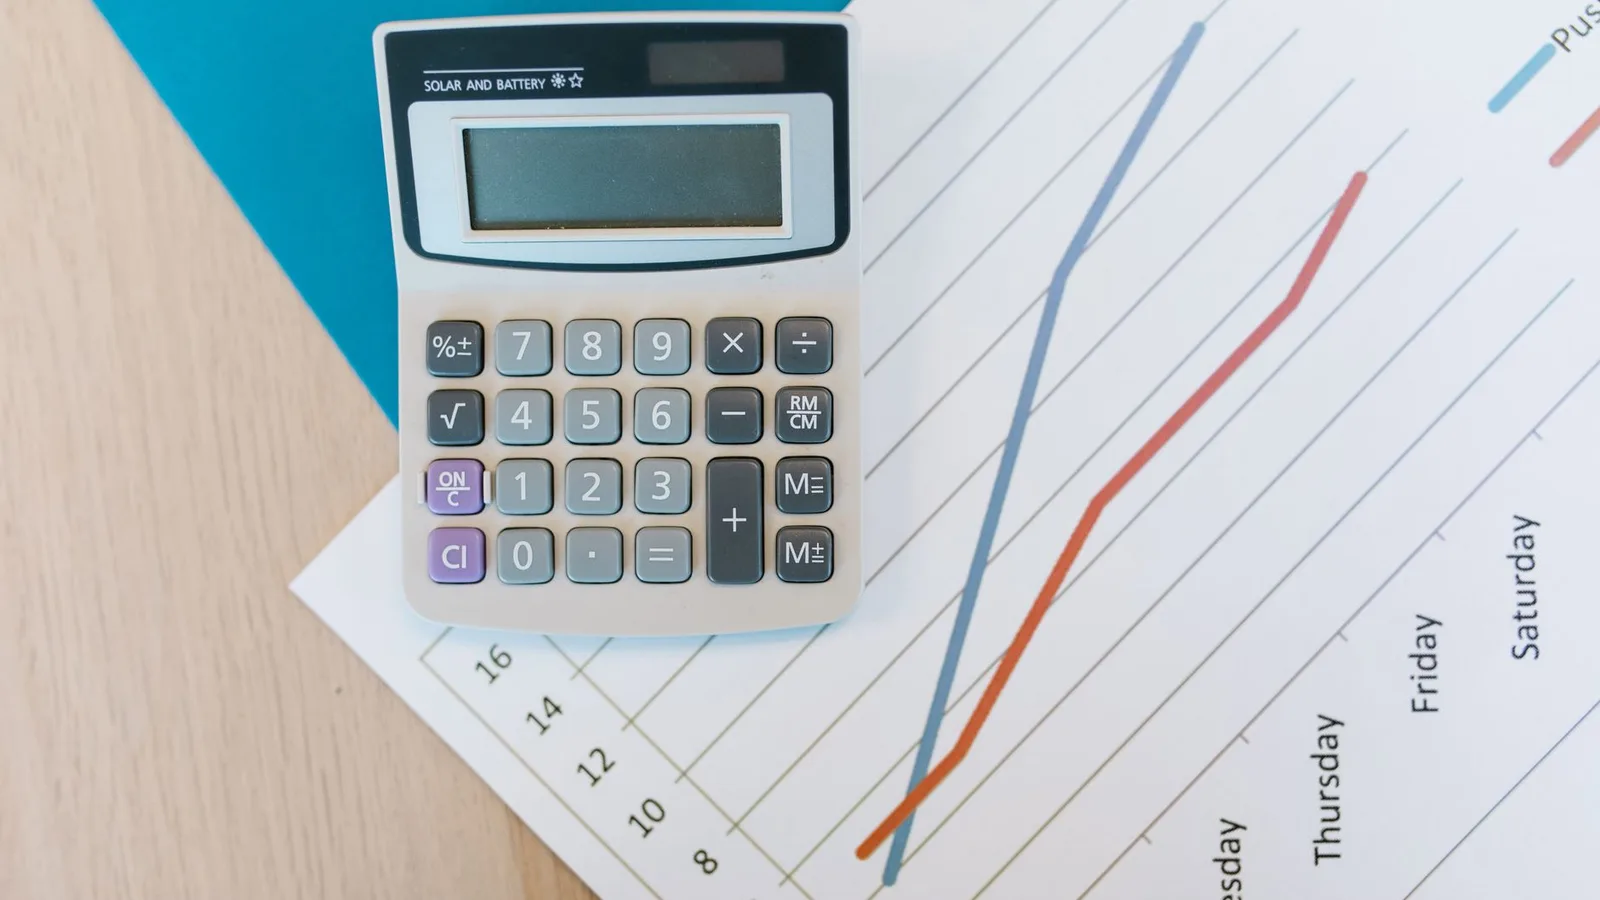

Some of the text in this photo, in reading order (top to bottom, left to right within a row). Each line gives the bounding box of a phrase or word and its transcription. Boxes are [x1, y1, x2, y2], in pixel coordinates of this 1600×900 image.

[1551, 0, 1600, 53] Pus
[424, 79, 545, 91] SOLAR AND BATTERY
[513, 332, 530, 360] 7
[582, 331, 601, 360] 8
[653, 332, 671, 360] 9
[511, 401, 532, 429] 4
[583, 401, 599, 429] 5
[652, 401, 670, 429] 6
[791, 396, 817, 410] RM
[790, 414, 817, 429] CM
[439, 472, 465, 487] ON
[515, 472, 526, 500] 1
[582, 473, 600, 501] 2
[652, 471, 670, 500] 3
[448, 491, 458, 506] C
[513, 541, 532, 570] 0
[1506, 515, 1540, 659] Saturday
[476, 644, 512, 684] 16
[1409, 615, 1442, 712] Friday
[527, 697, 562, 734] 14
[578, 748, 615, 786] 12
[1310, 715, 1344, 866] Thursday
[629, 799, 665, 838] 10
[694, 850, 718, 874] 8
